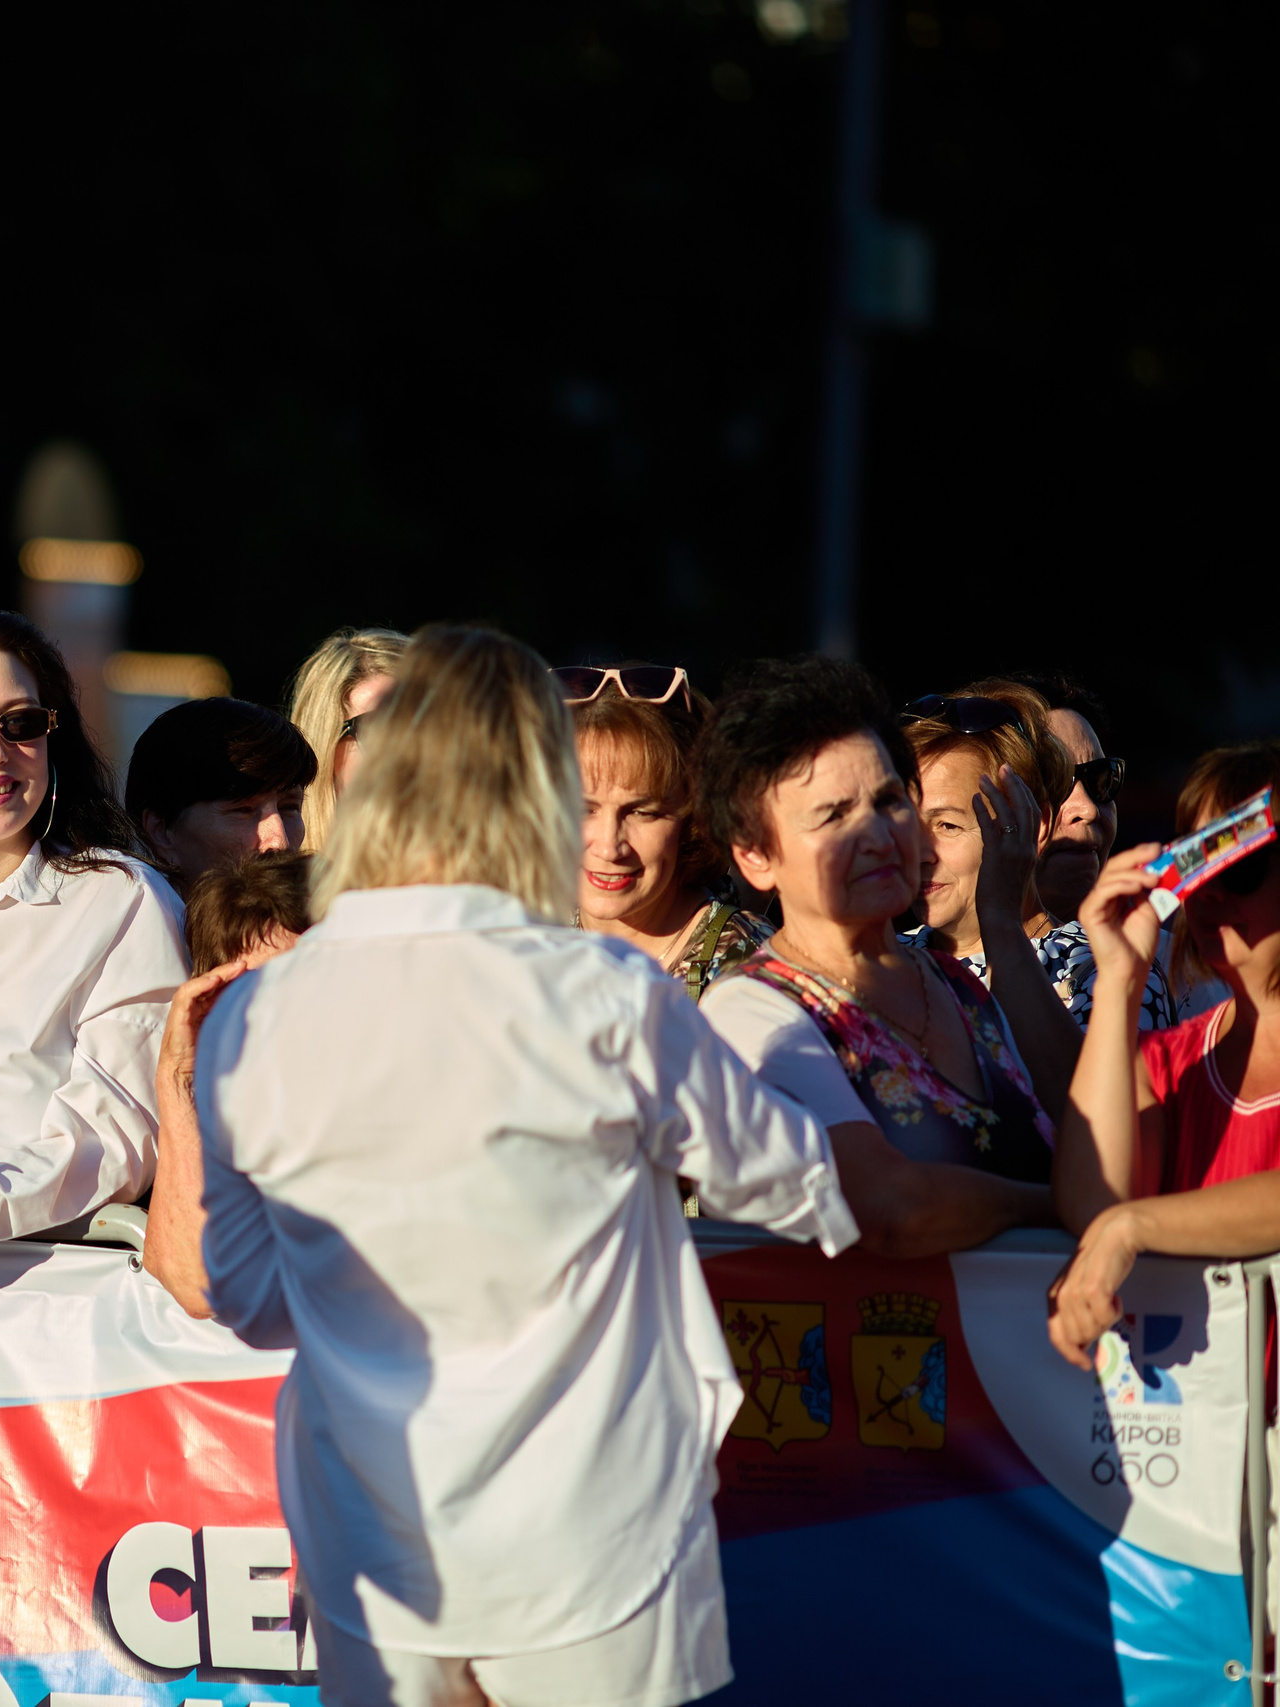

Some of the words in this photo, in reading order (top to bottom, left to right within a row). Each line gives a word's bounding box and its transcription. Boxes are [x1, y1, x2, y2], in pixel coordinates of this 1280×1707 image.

[1091, 1423, 1181, 1446] КИРОВ
[1091, 1451, 1179, 1487] 650
[94, 1521, 318, 1681] СЕ
